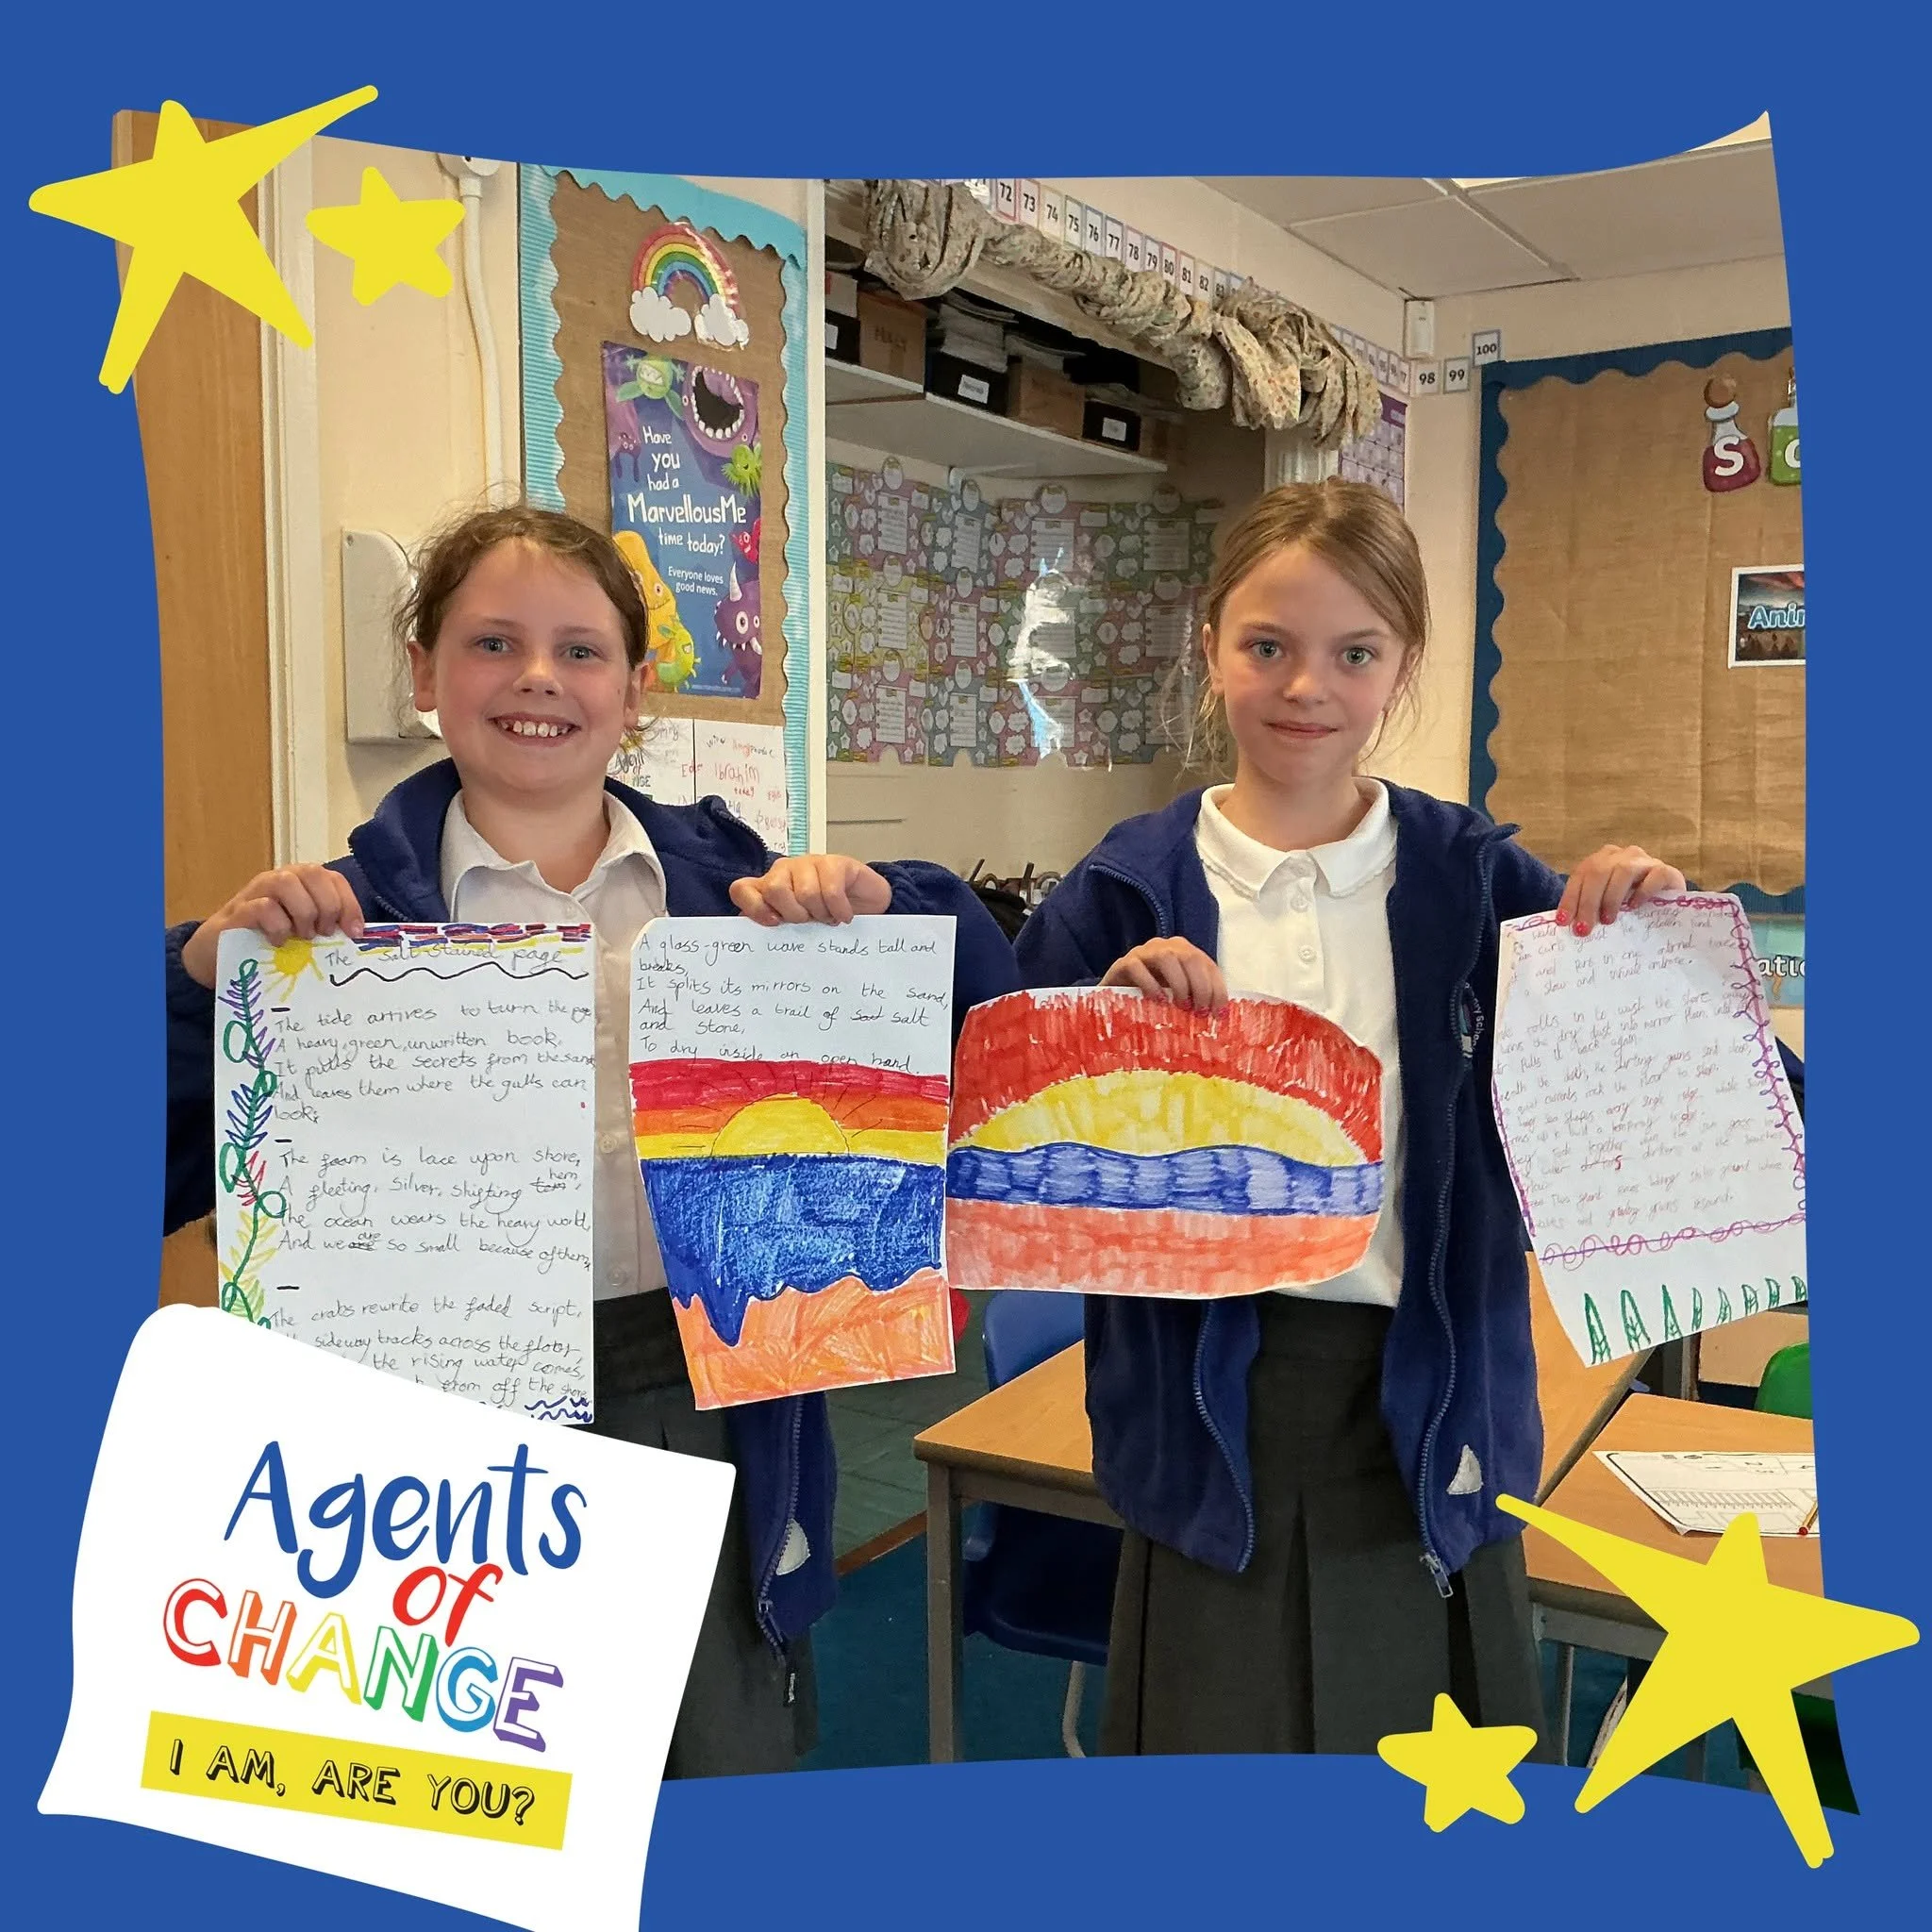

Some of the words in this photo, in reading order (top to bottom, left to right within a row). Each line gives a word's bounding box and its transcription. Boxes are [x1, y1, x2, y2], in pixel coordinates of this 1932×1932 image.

[999, 182, 1012, 202] 72
[1023, 193, 1036, 212] 73
[1046, 204, 1058, 223] 74
[1068, 214, 1079, 233] 75
[1089, 224, 1099, 242] 76
[1108, 234, 1120, 251] 77
[1128, 243, 1140, 260] 78
[1147, 253, 1158, 269] 79
[1164, 258, 1174, 276] 80
[1182, 267, 1191, 284] 81
[1199, 275, 1209, 291] 82
[1419, 372, 1436, 386] 98
[1449, 369, 1465, 382] 99
[1476, 343, 1497, 355] 100
[642, 425, 672, 444] Have
[652, 453, 680, 473] you
[647, 473, 669, 491] had
[673, 477, 679, 489] a
[627, 492, 747, 524] MarvellousMe
[658, 528, 683, 546] time
[688, 532, 725, 557] today?
[668, 566, 703, 582] Everyone
[705, 572, 724, 584] loves
[675, 582, 694, 593] good
[696, 585, 718, 595] news.
[639, 935, 652, 952] A
[767, 941, 805, 953] wave
[817, 939, 869, 956] stands
[878, 937, 906, 953] tall
[910, 941, 937, 955] and
[325, 953, 353, 967] The
[512, 947, 563, 974] page
[635, 977, 657, 991] It
[667, 978, 711, 1001] splits
[719, 976, 741, 995] its
[751, 981, 811, 994] mirrors
[822, 984, 841, 994] on
[861, 983, 885, 998] the
[275, 1018, 304, 1033] The
[318, 1010, 353, 1026] tide
[367, 1008, 437, 1024] arrives
[460, 1004, 480, 1017] to
[488, 1000, 537, 1017] turn
[637, 999, 673, 1016] And
[691, 999, 741, 1017] leaves
[751, 1007, 762, 1016] a
[774, 1005, 812, 1019] trail
[275, 1038, 287, 1052] A
[639, 1035, 658, 1052] To
[275, 1060, 297, 1077] It
[369, 1052, 395, 1070] the
[412, 1050, 477, 1068] secrets
[358, 1077, 401, 1097] them
[279, 1149, 308, 1168] The
[382, 1148, 403, 1166] is
[419, 1146, 457, 1165] lace
[470, 1152, 518, 1175] upon
[278, 1175, 293, 1197] A
[324, 1216, 374, 1228] ocean
[391, 1212, 446, 1225] wears
[459, 1211, 489, 1228] the
[276, 1230, 315, 1251] And
[361, 1292, 419, 1314] rewrite
[433, 1295, 455, 1312] the
[377, 1325, 433, 1349] tracks
[498, 1333, 519, 1352] the
[373, 1353, 398, 1370] the
